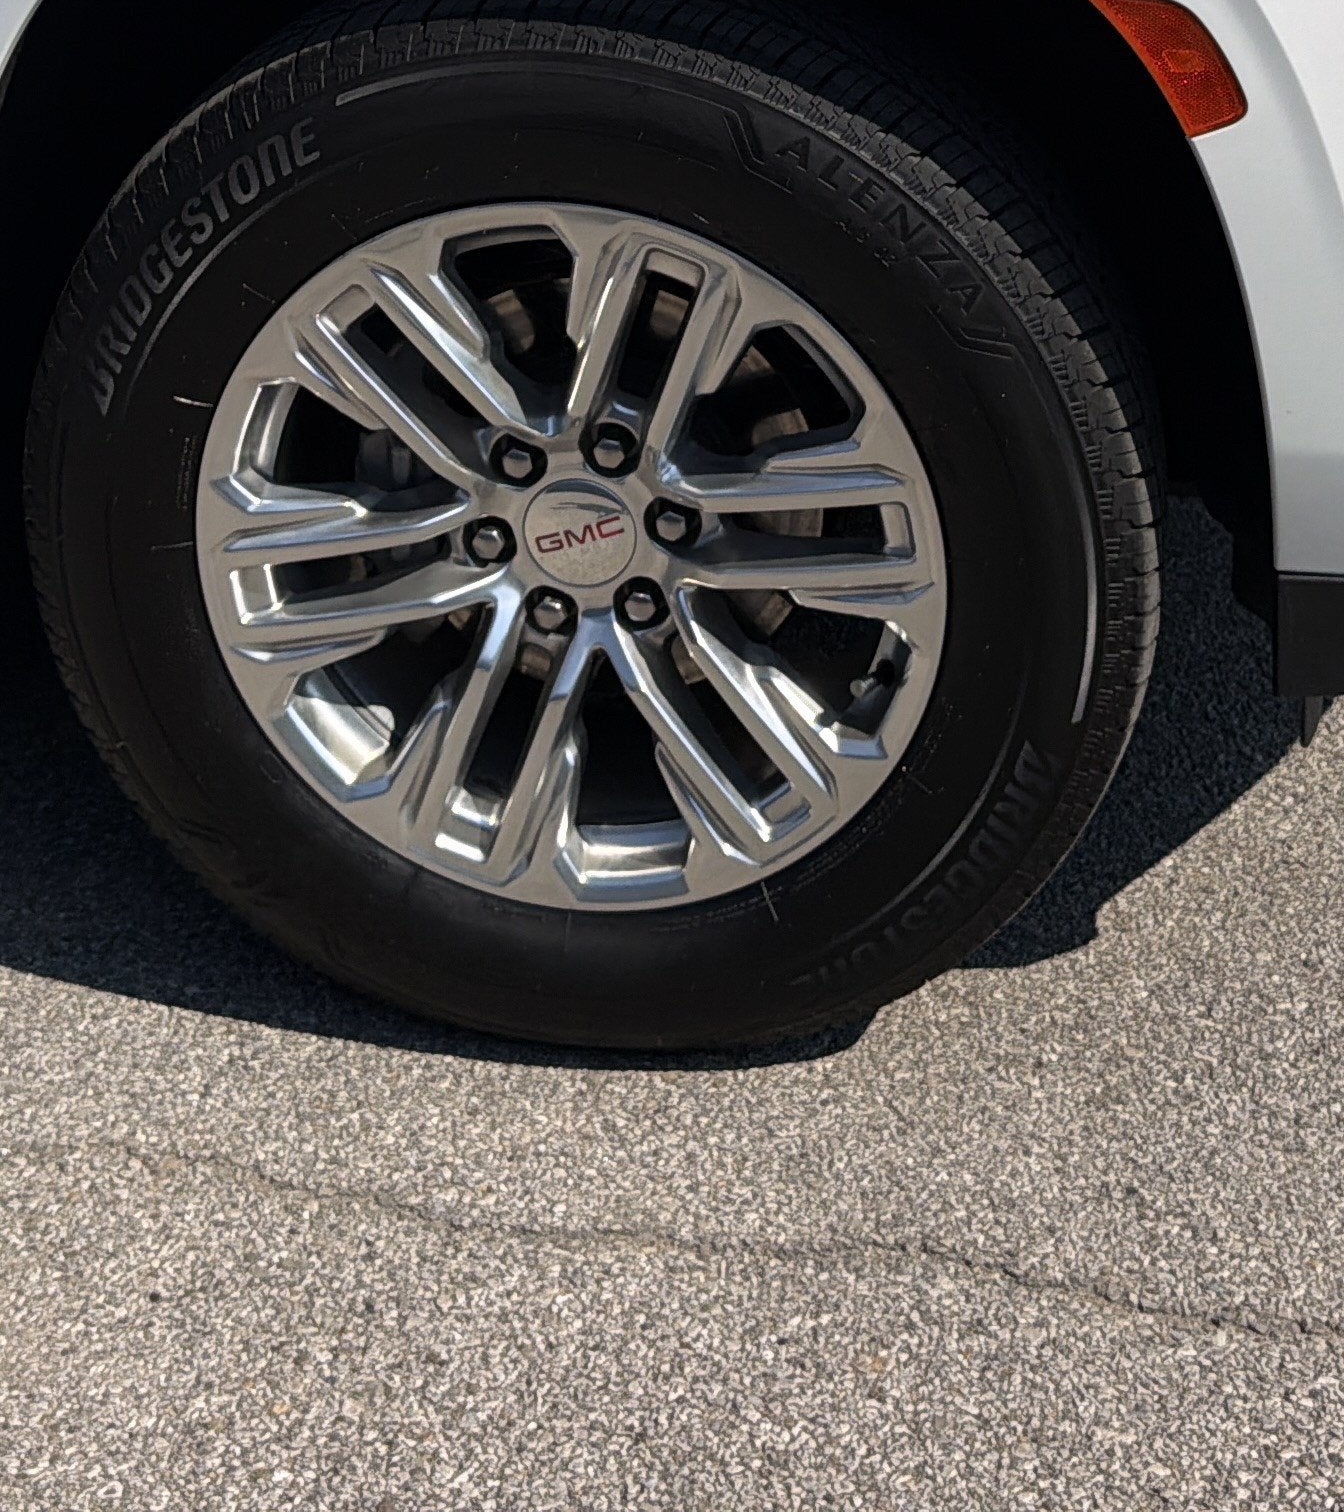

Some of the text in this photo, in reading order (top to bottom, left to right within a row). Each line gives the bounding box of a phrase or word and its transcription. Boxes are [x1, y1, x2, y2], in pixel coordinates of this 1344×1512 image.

[81, 116, 320, 418] BRIDGESTONE
[774, 136, 989, 318] ALENZA
[535, 515, 625, 554] GMC
